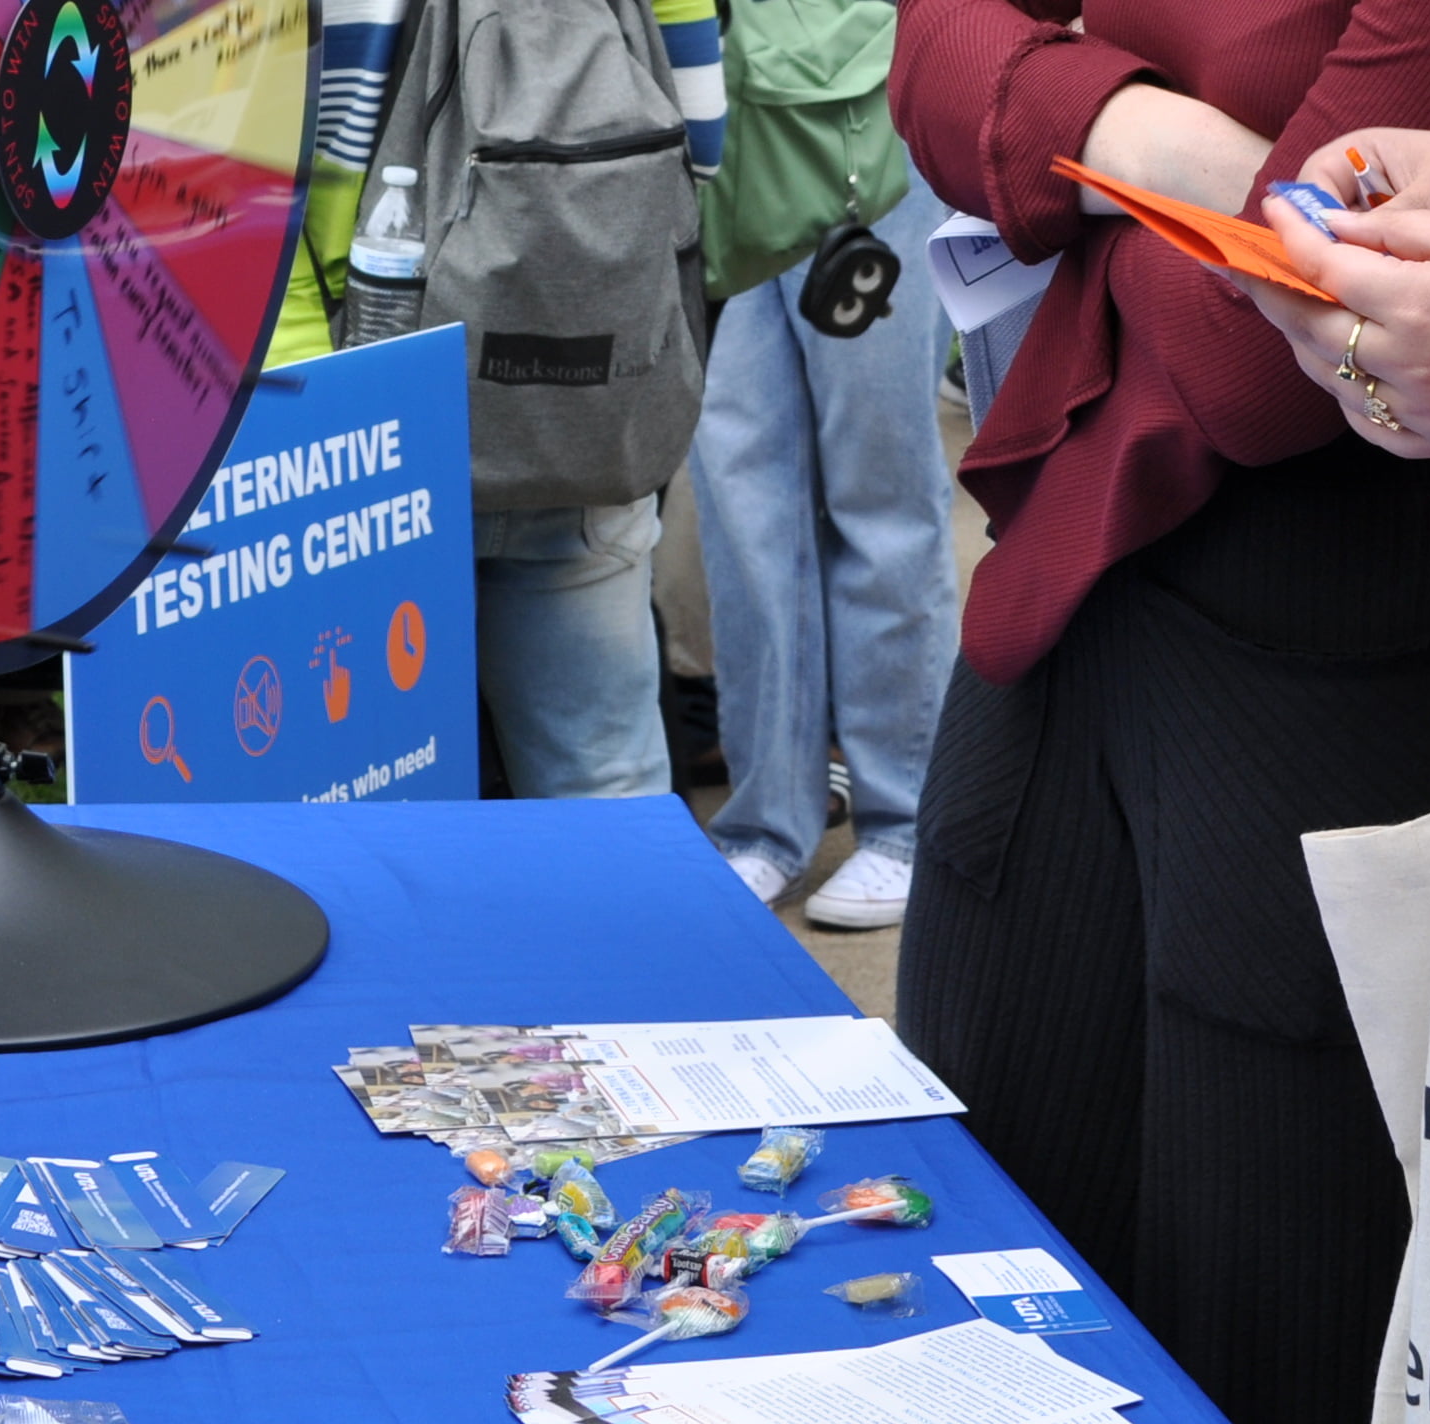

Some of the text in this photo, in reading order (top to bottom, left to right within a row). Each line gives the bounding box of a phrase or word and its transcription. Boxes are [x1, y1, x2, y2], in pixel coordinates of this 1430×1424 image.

[97, 4, 128, 71] SPIN
[1, 9, 40, 210] SPIN TO WIN
[115, 80, 130, 122] TO
[93, 135, 124, 198] WIN
[485, 357, 603, 381] Blackstone
[182, 419, 401, 533] LTERNATIVE
[129, 488, 433, 636] TESTING CENTER
[352, 763, 391, 799] who
[394, 735, 435, 780] need
[73, 1172, 98, 1192] UTA
[132, 1163, 158, 1182] UTA
[191, 1301, 222, 1322] UTA
[1010, 1296, 1043, 1323] UTA
